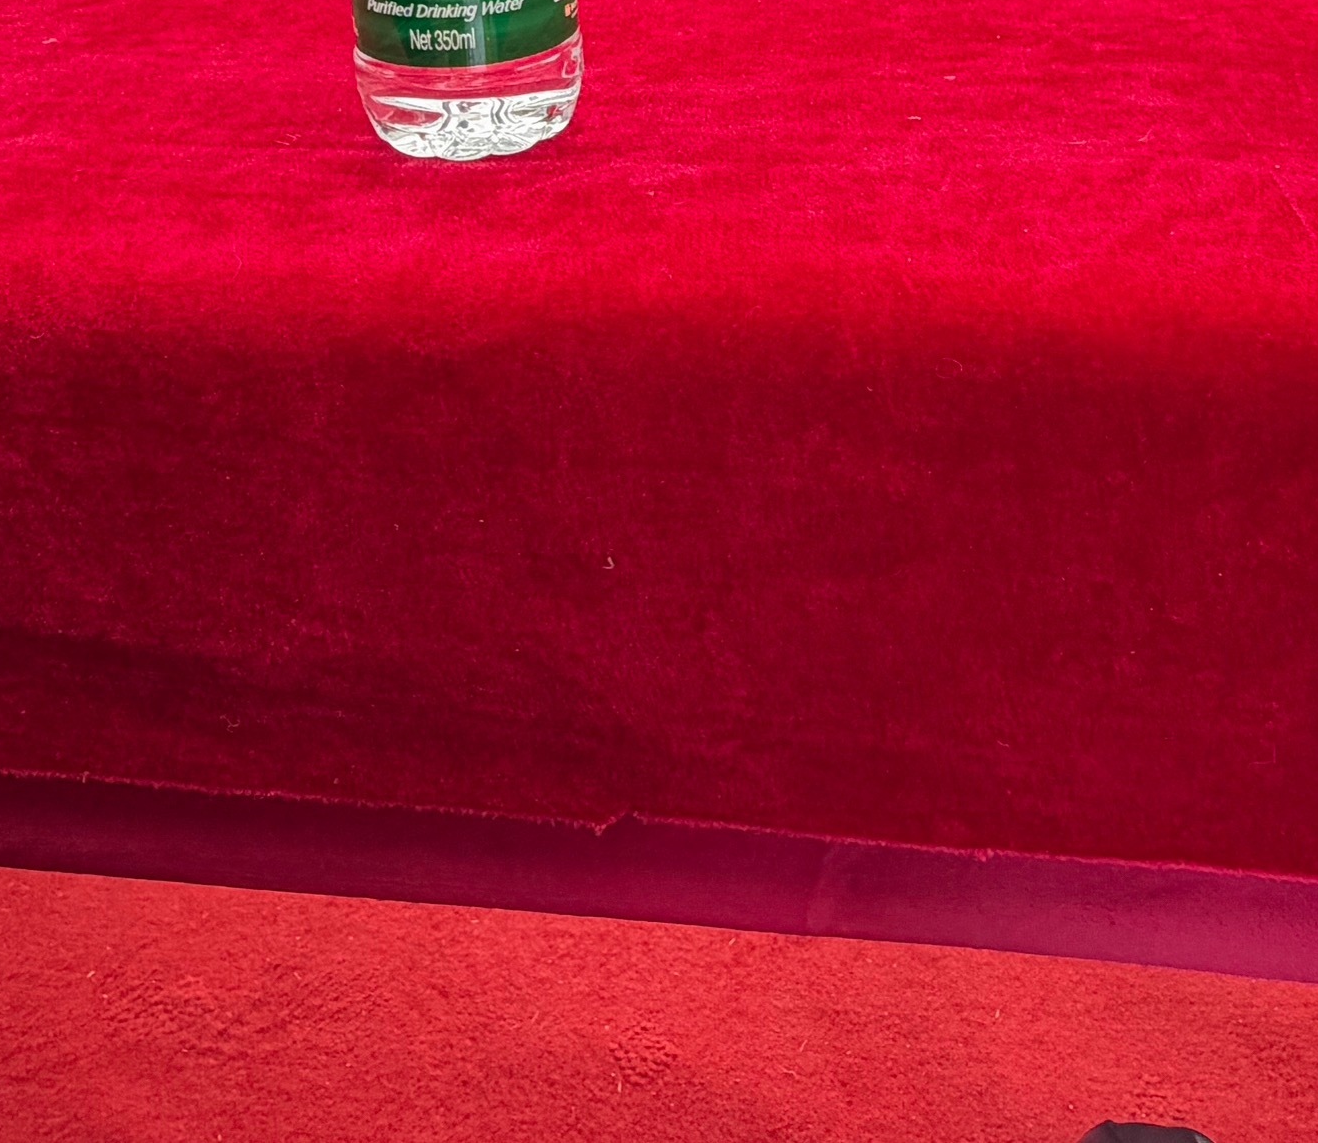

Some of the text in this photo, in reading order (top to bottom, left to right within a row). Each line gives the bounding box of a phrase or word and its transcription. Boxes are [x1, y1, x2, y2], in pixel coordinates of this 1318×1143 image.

[415, 4, 477, 23] Drinking
[410, 27, 476, 50] Net 350ml
